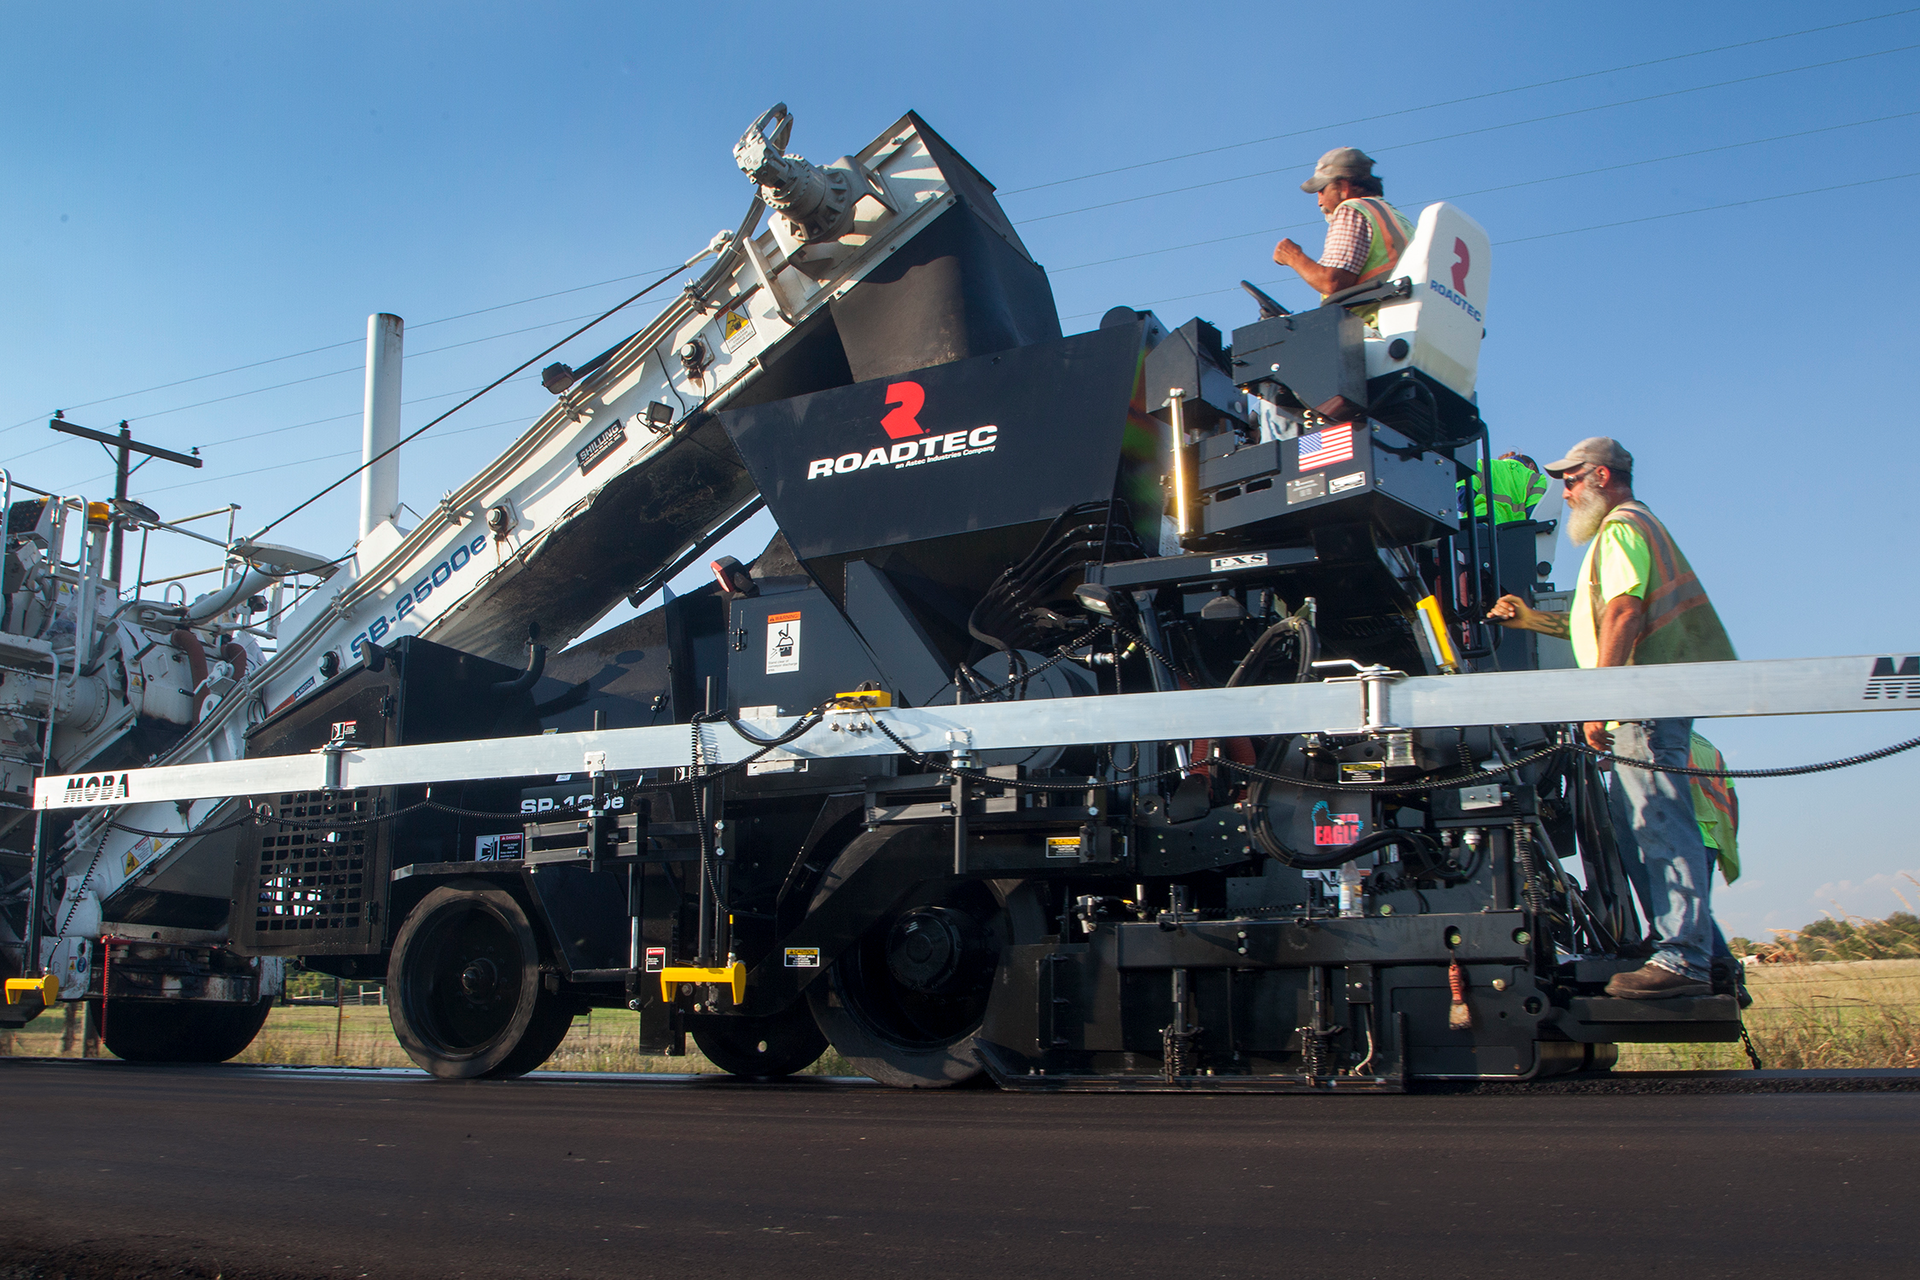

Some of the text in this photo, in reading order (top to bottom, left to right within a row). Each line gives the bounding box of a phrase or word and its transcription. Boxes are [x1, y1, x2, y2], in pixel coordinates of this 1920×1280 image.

[1430, 279, 1482, 322] ROADTEC
[580, 424, 619, 460] SHILLING
[807, 424, 998, 480] ROADTEC
[895, 445, 996, 470] an Astec Industries Company
[350, 534, 487, 659] SB-2500e
[63, 773, 130, 803] MOBA
[1315, 825, 1359, 845] EAGLE
